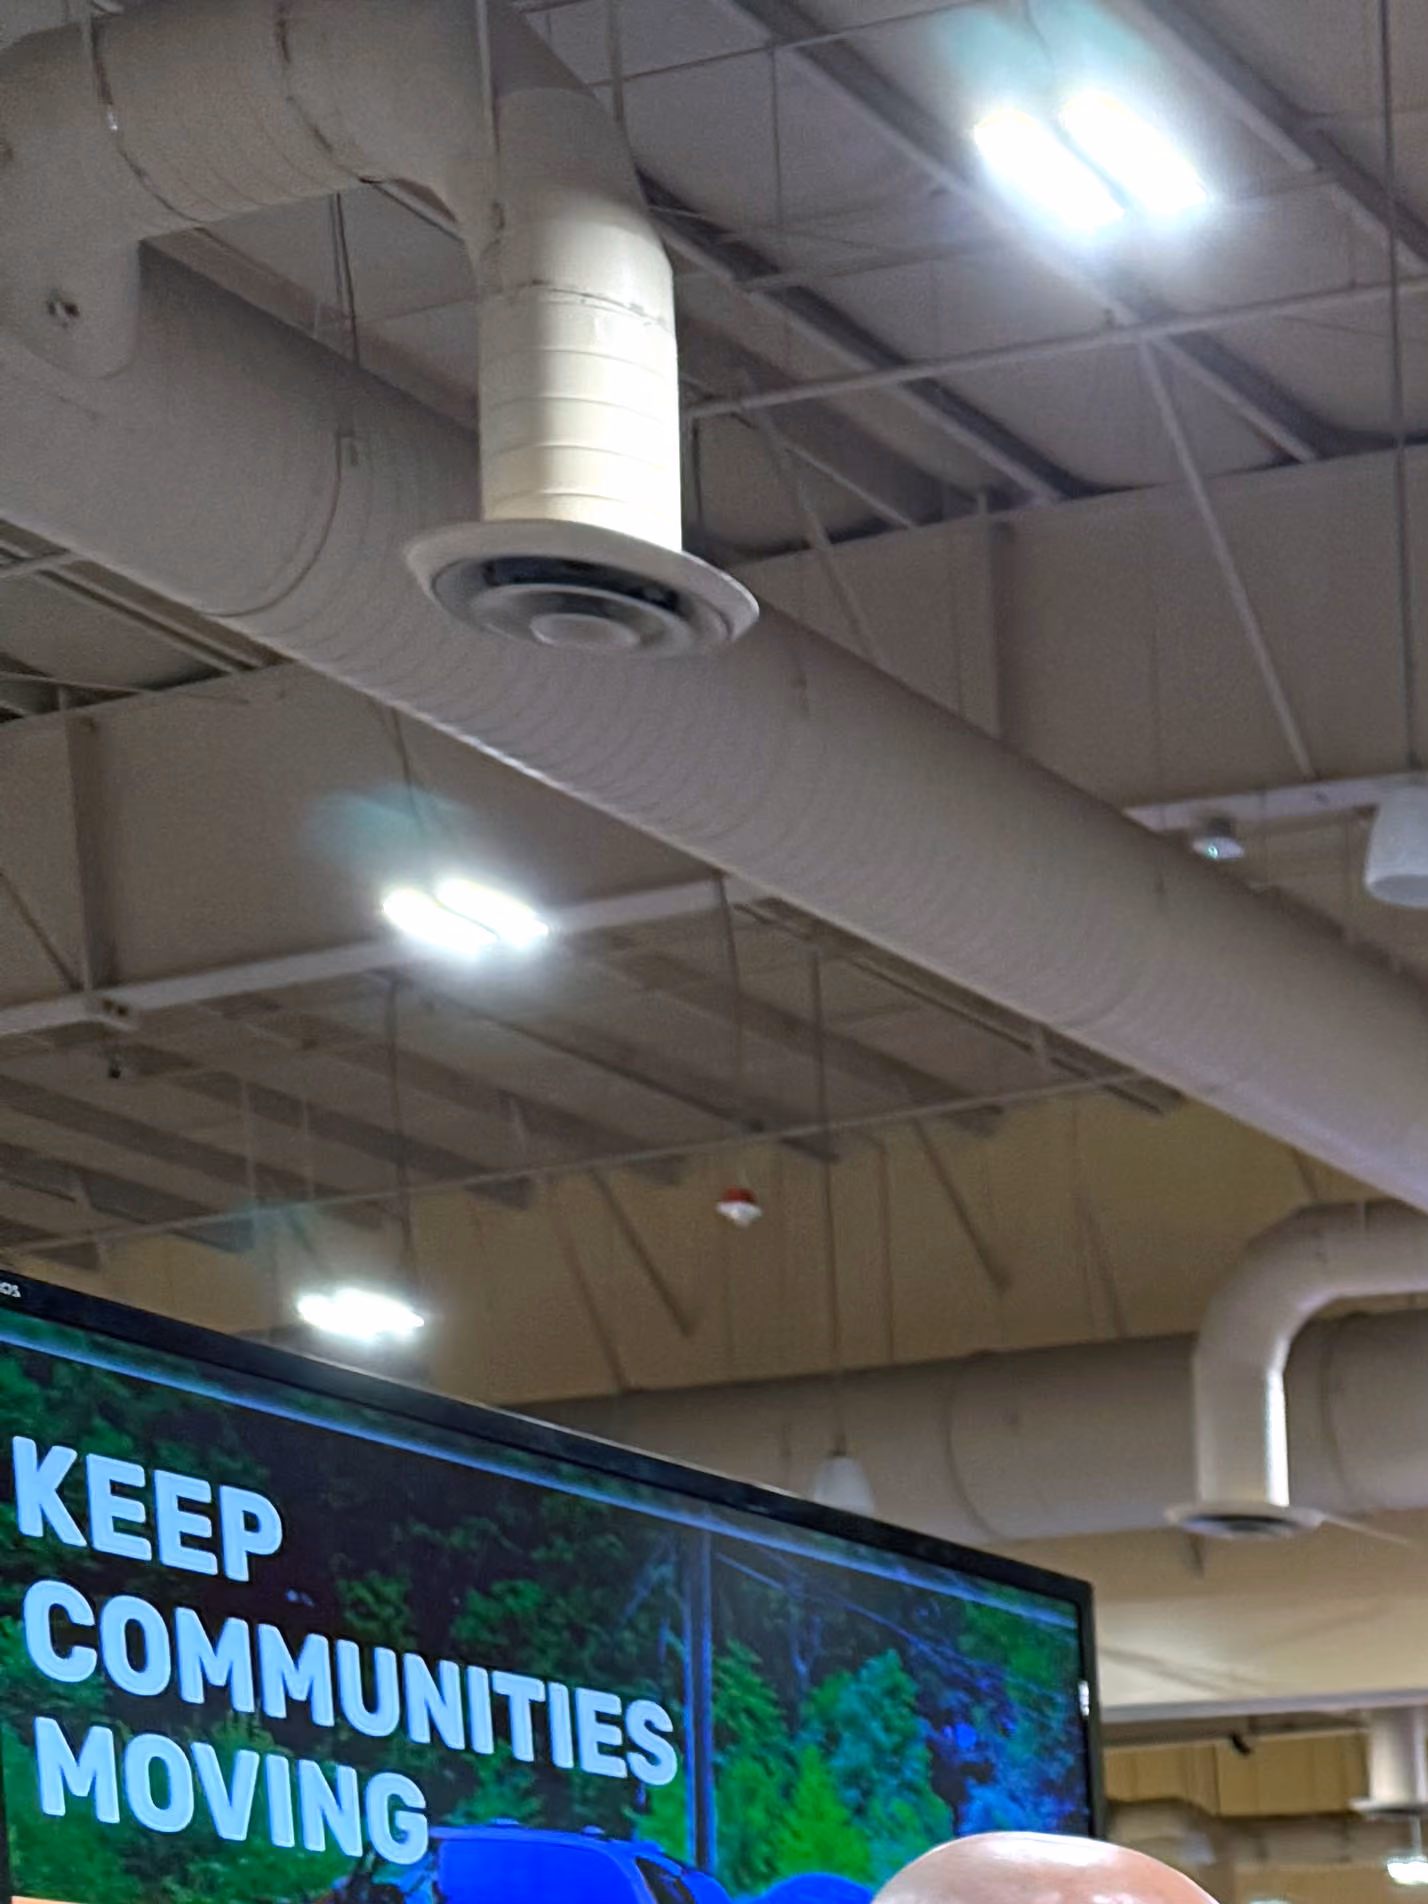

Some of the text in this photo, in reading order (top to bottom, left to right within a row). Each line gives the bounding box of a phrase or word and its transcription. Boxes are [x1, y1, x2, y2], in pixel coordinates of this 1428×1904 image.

[12, 1436, 283, 1582] KEEP
[23, 1579, 678, 1786] COMMUNITIES
[34, 1716, 429, 1864] MOVING
